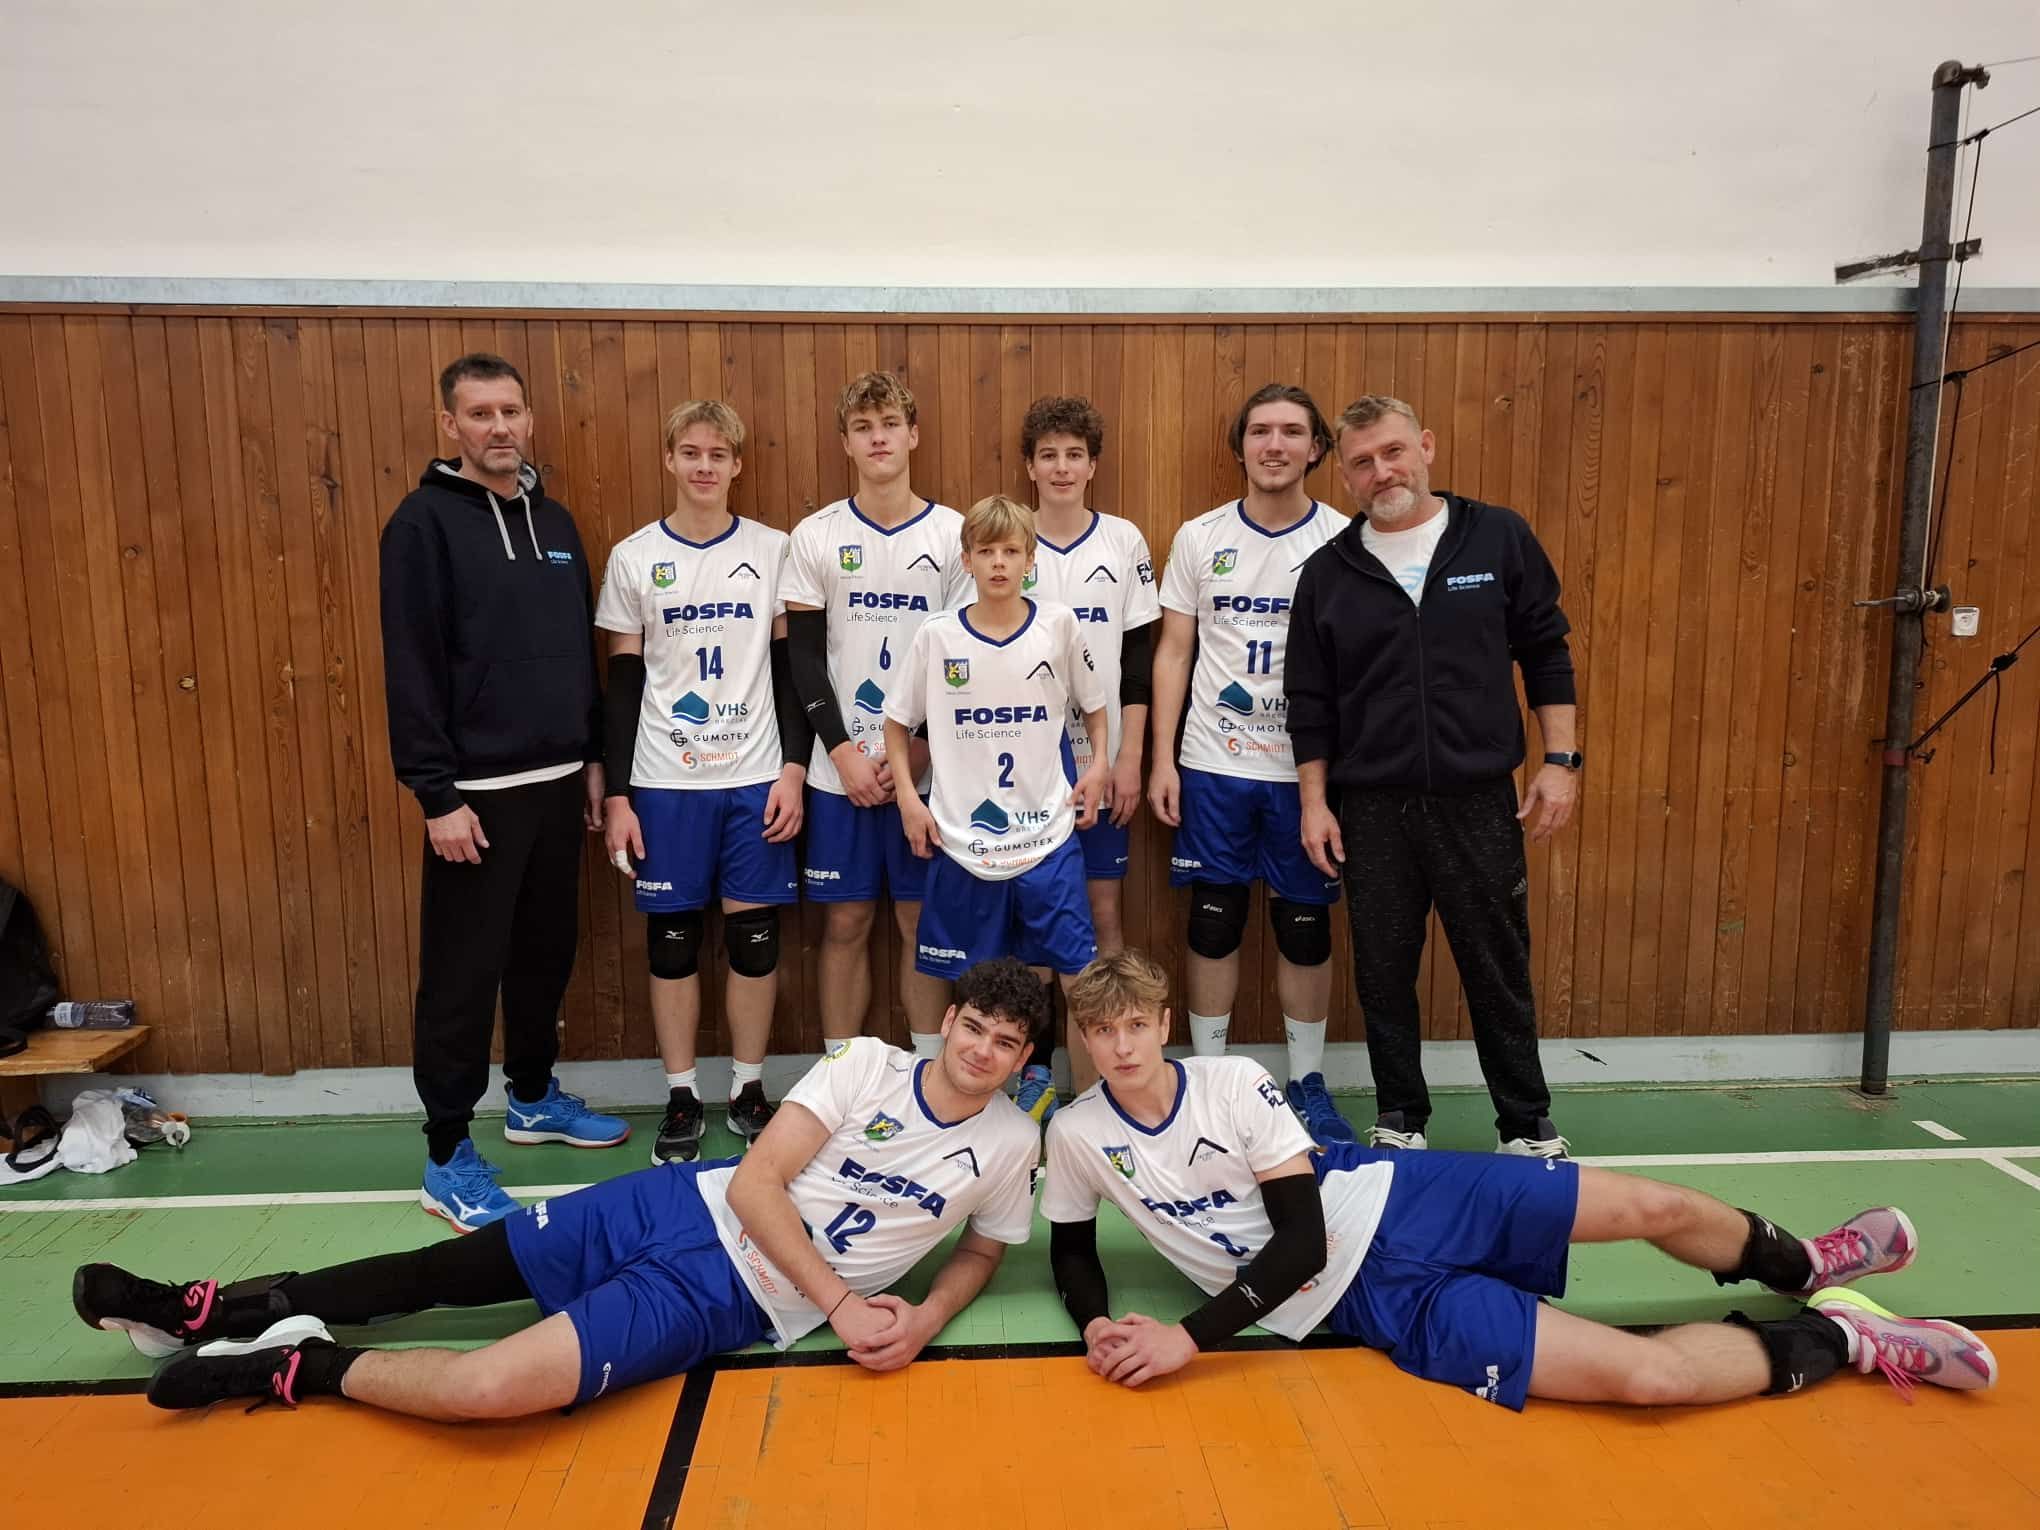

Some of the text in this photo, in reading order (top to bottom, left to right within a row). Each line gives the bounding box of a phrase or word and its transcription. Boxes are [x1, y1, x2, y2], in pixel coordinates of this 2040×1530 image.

[1447, 572, 1495, 586] FOSFA
[848, 591, 929, 612] FOSFA
[1212, 595, 1290, 614] FOSF
[662, 602, 754, 625] FOSFA
[846, 612, 898, 623] Life Science
[682, 624, 725, 635] Science
[1231, 616, 1278, 628] Science
[879, 636, 892, 671] 6
[1246, 639, 1272, 674] 11
[695, 645, 724, 681] 14
[715, 701, 749, 717] VHS
[1261, 697, 1288, 711] VH
[954, 704, 1049, 726] FOSFA
[955, 728, 1022, 740] Life Science
[1238, 724, 1283, 732] GUMOT
[693, 732, 750, 742] GUMOTEX
[699, 751, 738, 763] SCHMIDT
[997, 751, 1015, 788] 2
[1014, 809, 1050, 825] VHS
[993, 837, 1054, 853] GUMOTEX
[1171, 856, 1203, 869] OSFA
[636, 879, 673, 891] FOSFA
[919, 944, 967, 960] FOSFA
[838, 1157, 947, 1219] FOSFA
[824, 1201, 877, 1255] 12
[746, 1250, 779, 1297] SCHMIDT
